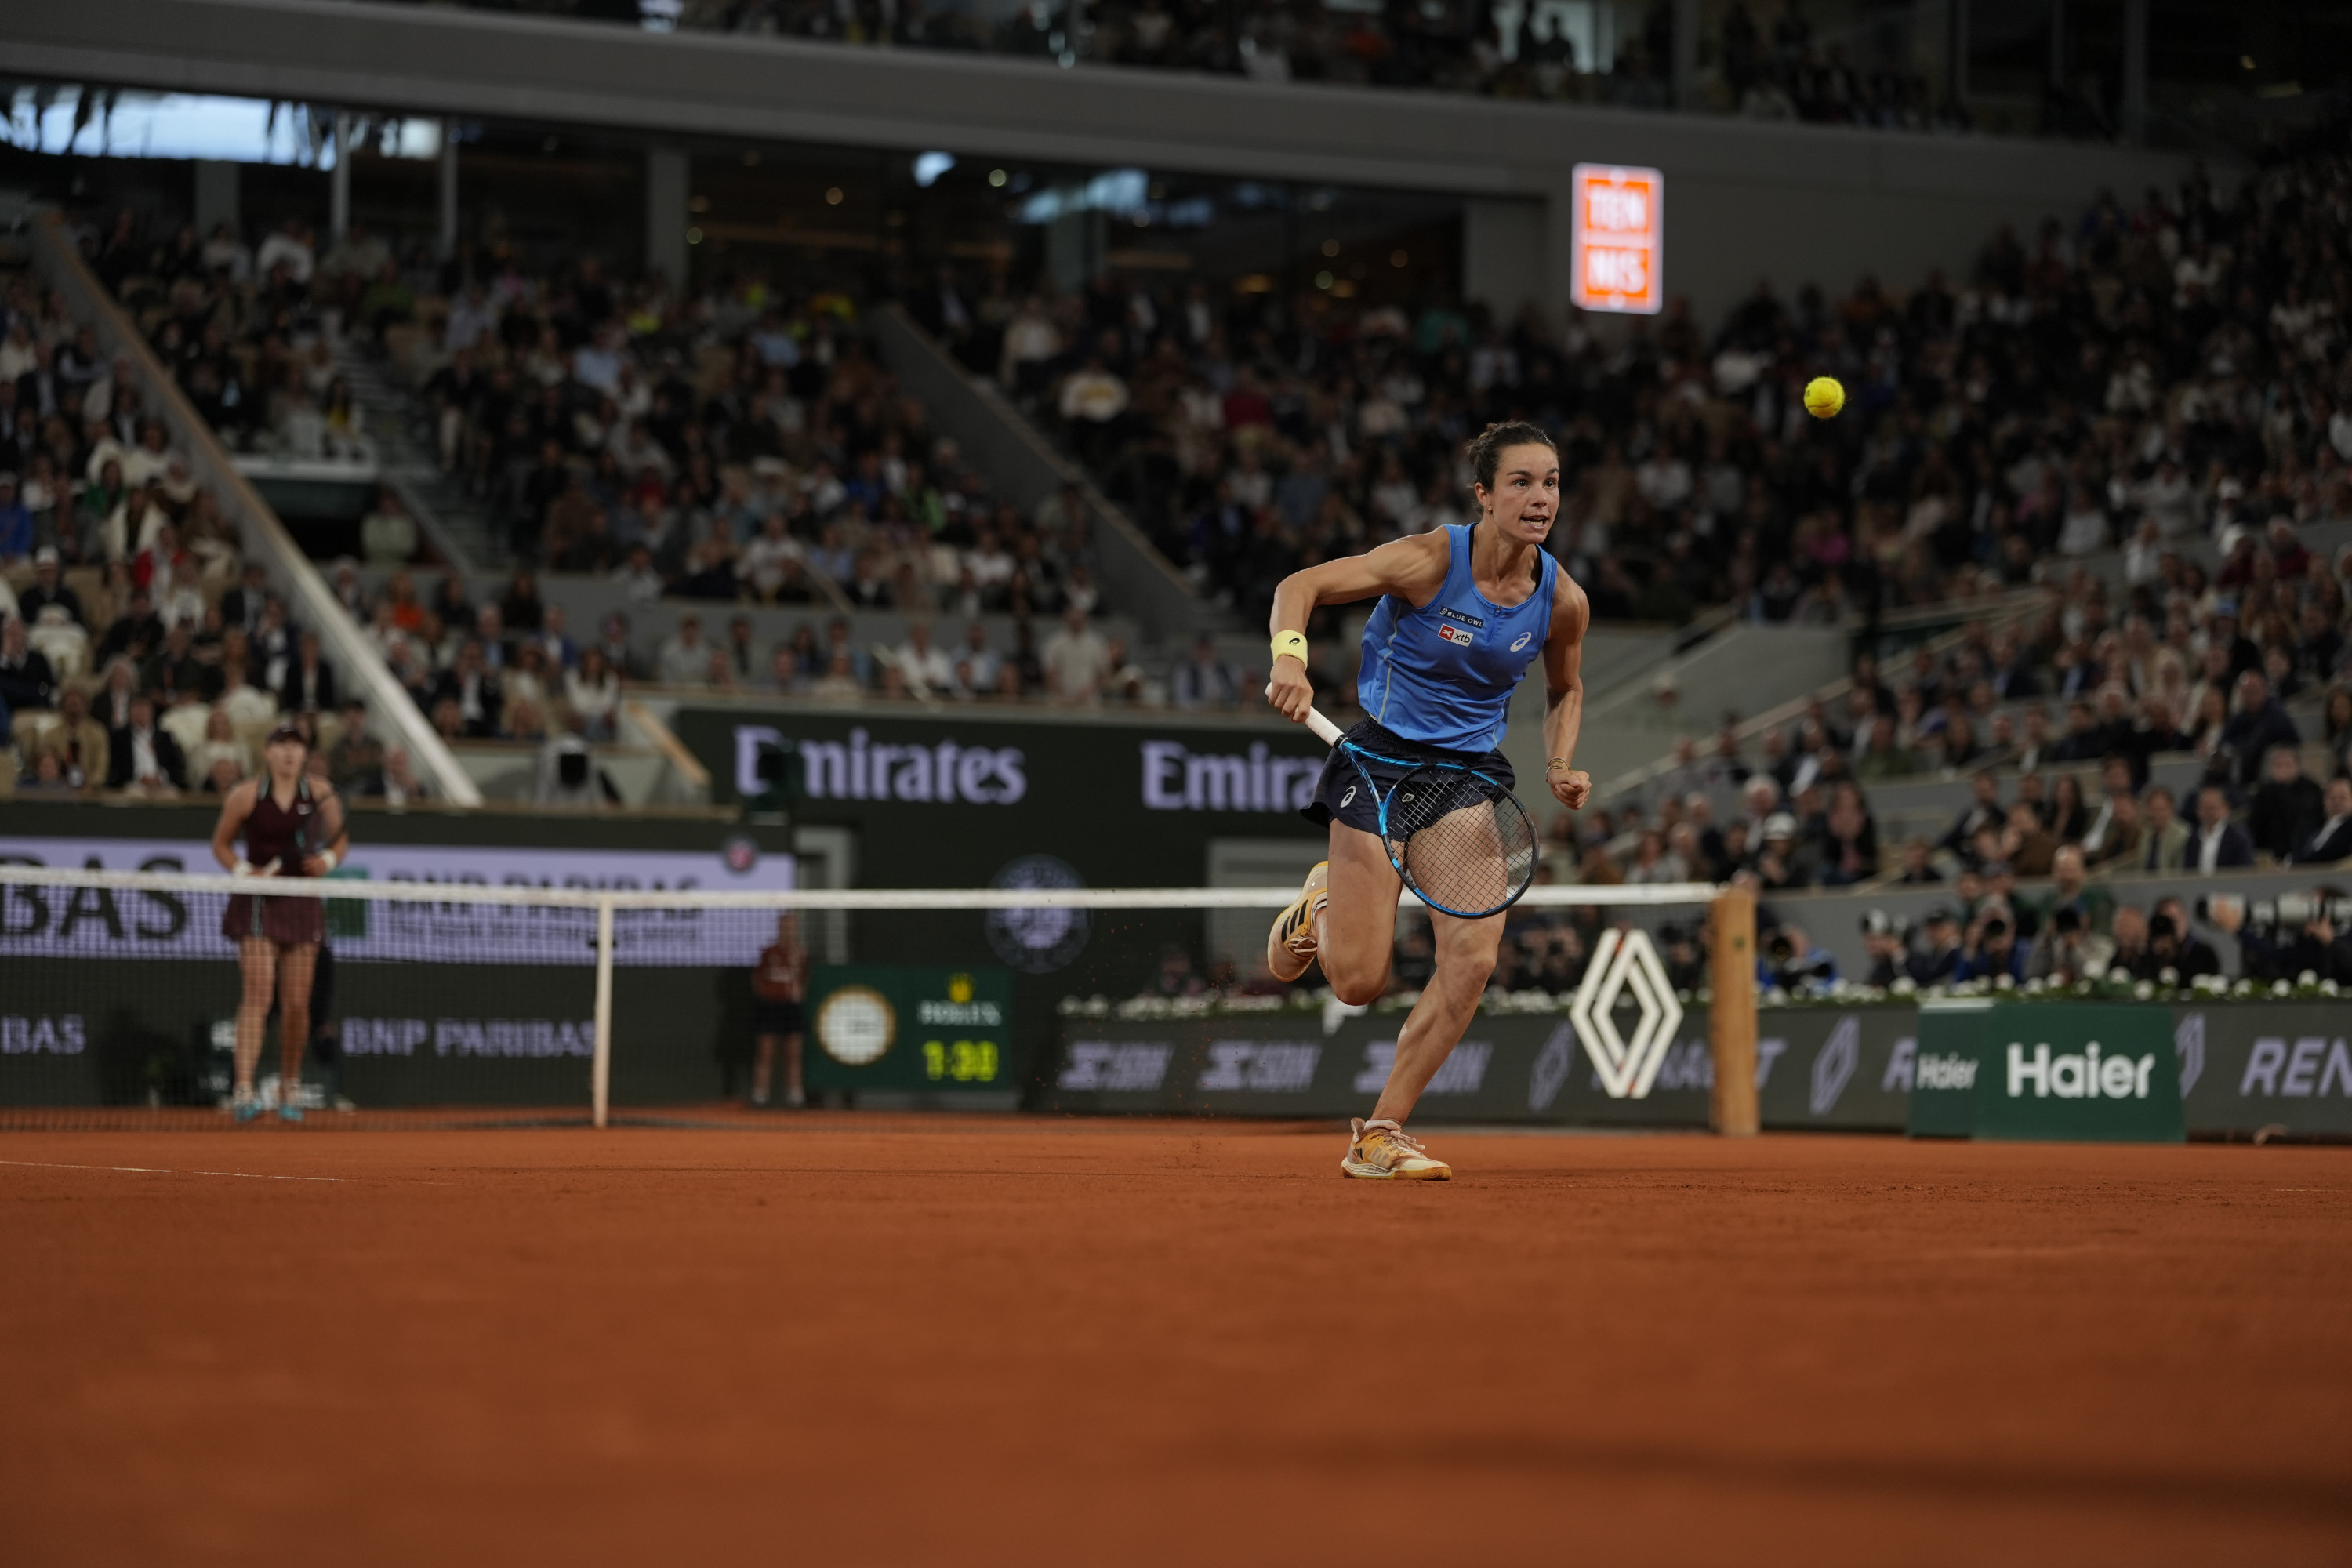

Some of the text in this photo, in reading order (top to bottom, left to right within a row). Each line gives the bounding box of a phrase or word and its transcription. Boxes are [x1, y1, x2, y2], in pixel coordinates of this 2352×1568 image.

[1588, 187, 1646, 228] TEN
[1588, 251, 1646, 292] NIS
[1446, 611, 1483, 627] BLUE OWL
[1454, 632, 1470, 644] xtb
[340, 1018, 427, 1057] BNP
[1917, 1051, 1979, 1090] Haier
[2007, 1040, 2155, 1098] Haier
